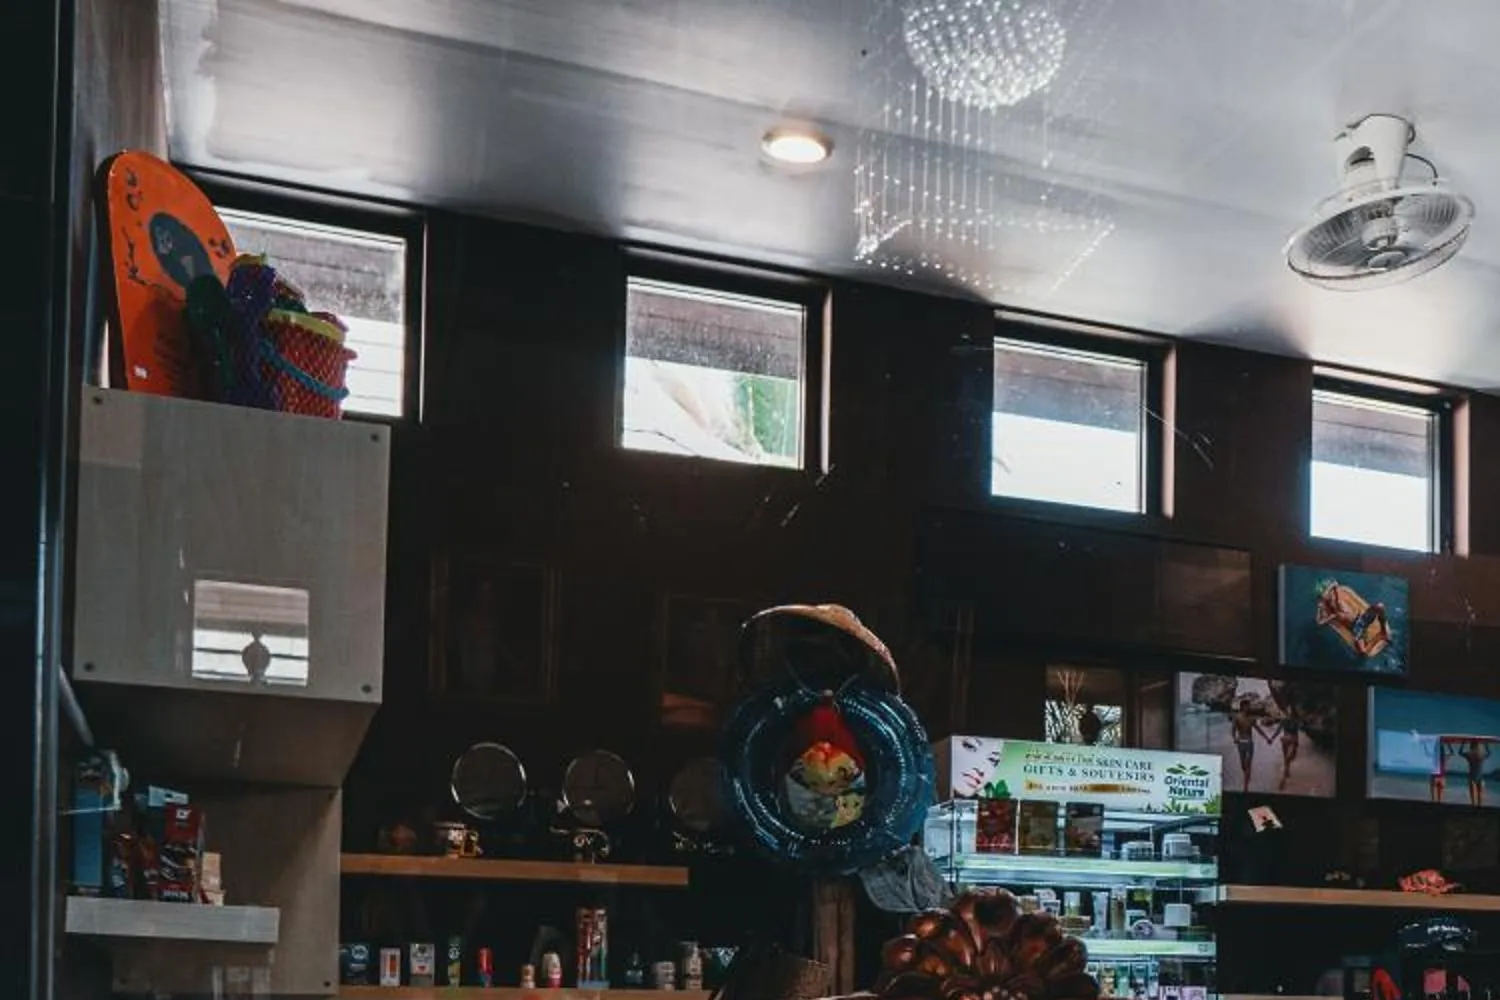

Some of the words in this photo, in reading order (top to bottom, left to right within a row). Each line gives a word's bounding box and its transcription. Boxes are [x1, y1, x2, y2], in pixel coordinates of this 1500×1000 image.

[1023, 764, 1063, 777] GIFTS
[1067, 767, 1077, 777] &
[1081, 768, 1156, 782] SOUVENIRS
[1163, 775, 1209, 789] Oriental
[1169, 785, 1205, 797] Nature
